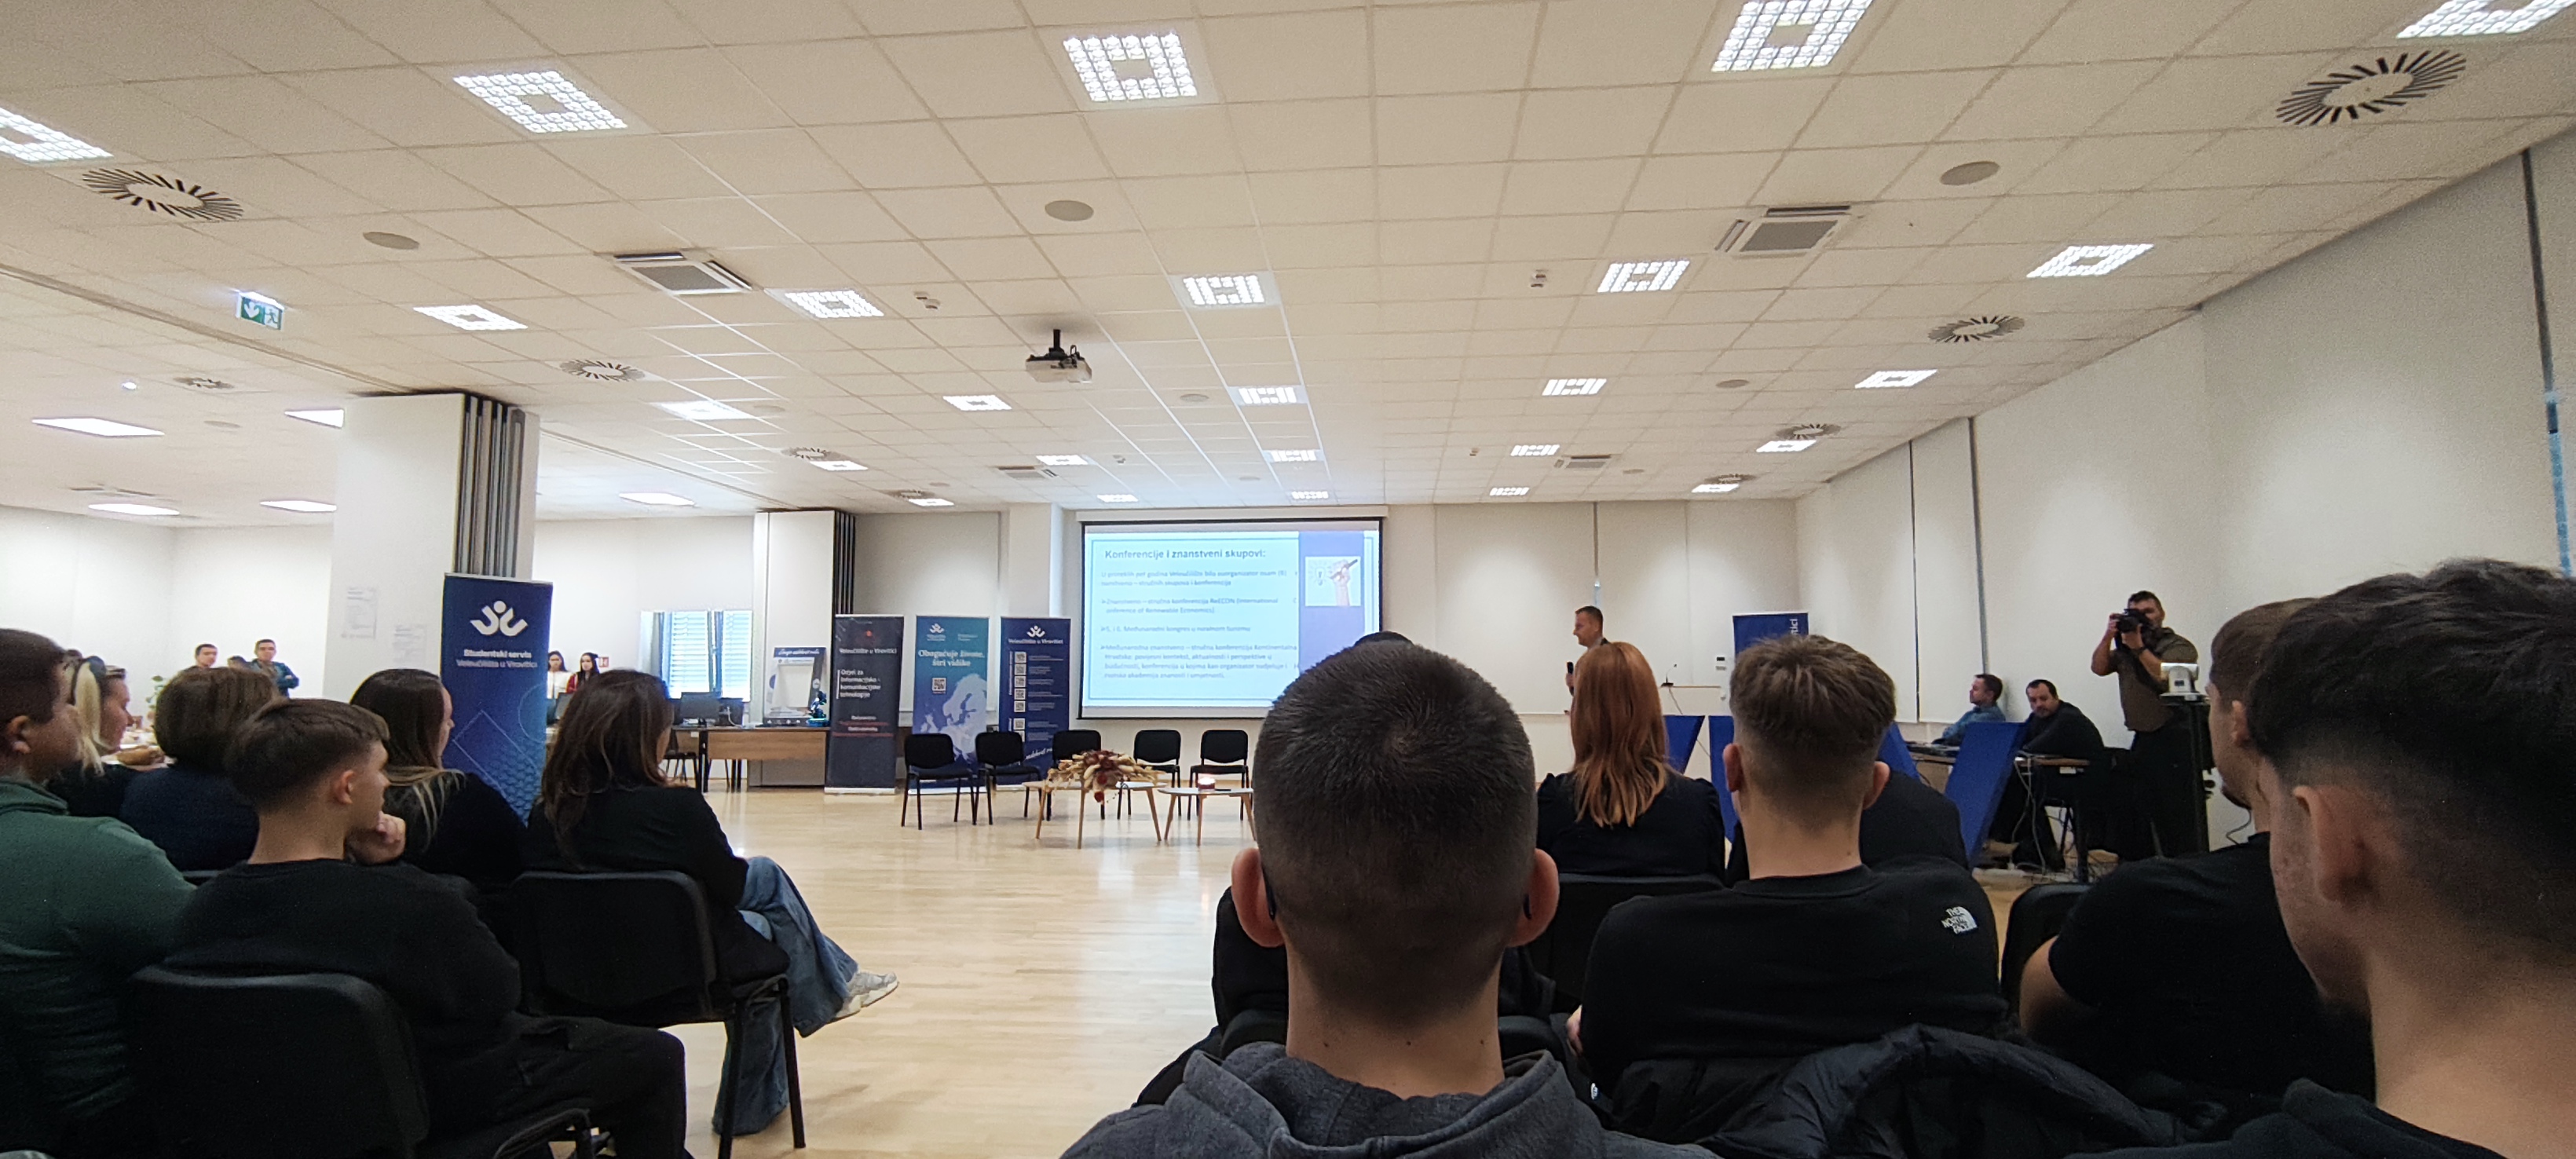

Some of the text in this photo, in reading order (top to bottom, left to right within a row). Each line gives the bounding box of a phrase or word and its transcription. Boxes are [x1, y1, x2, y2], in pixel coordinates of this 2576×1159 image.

[1105, 550, 1164, 560] Konferencije
[1172, 550, 1223, 558] znanstveni
[1224, 549, 1266, 559] skupovi:
[463, 649, 508, 658] Studentski
[1946, 907, 1961, 917] THE
